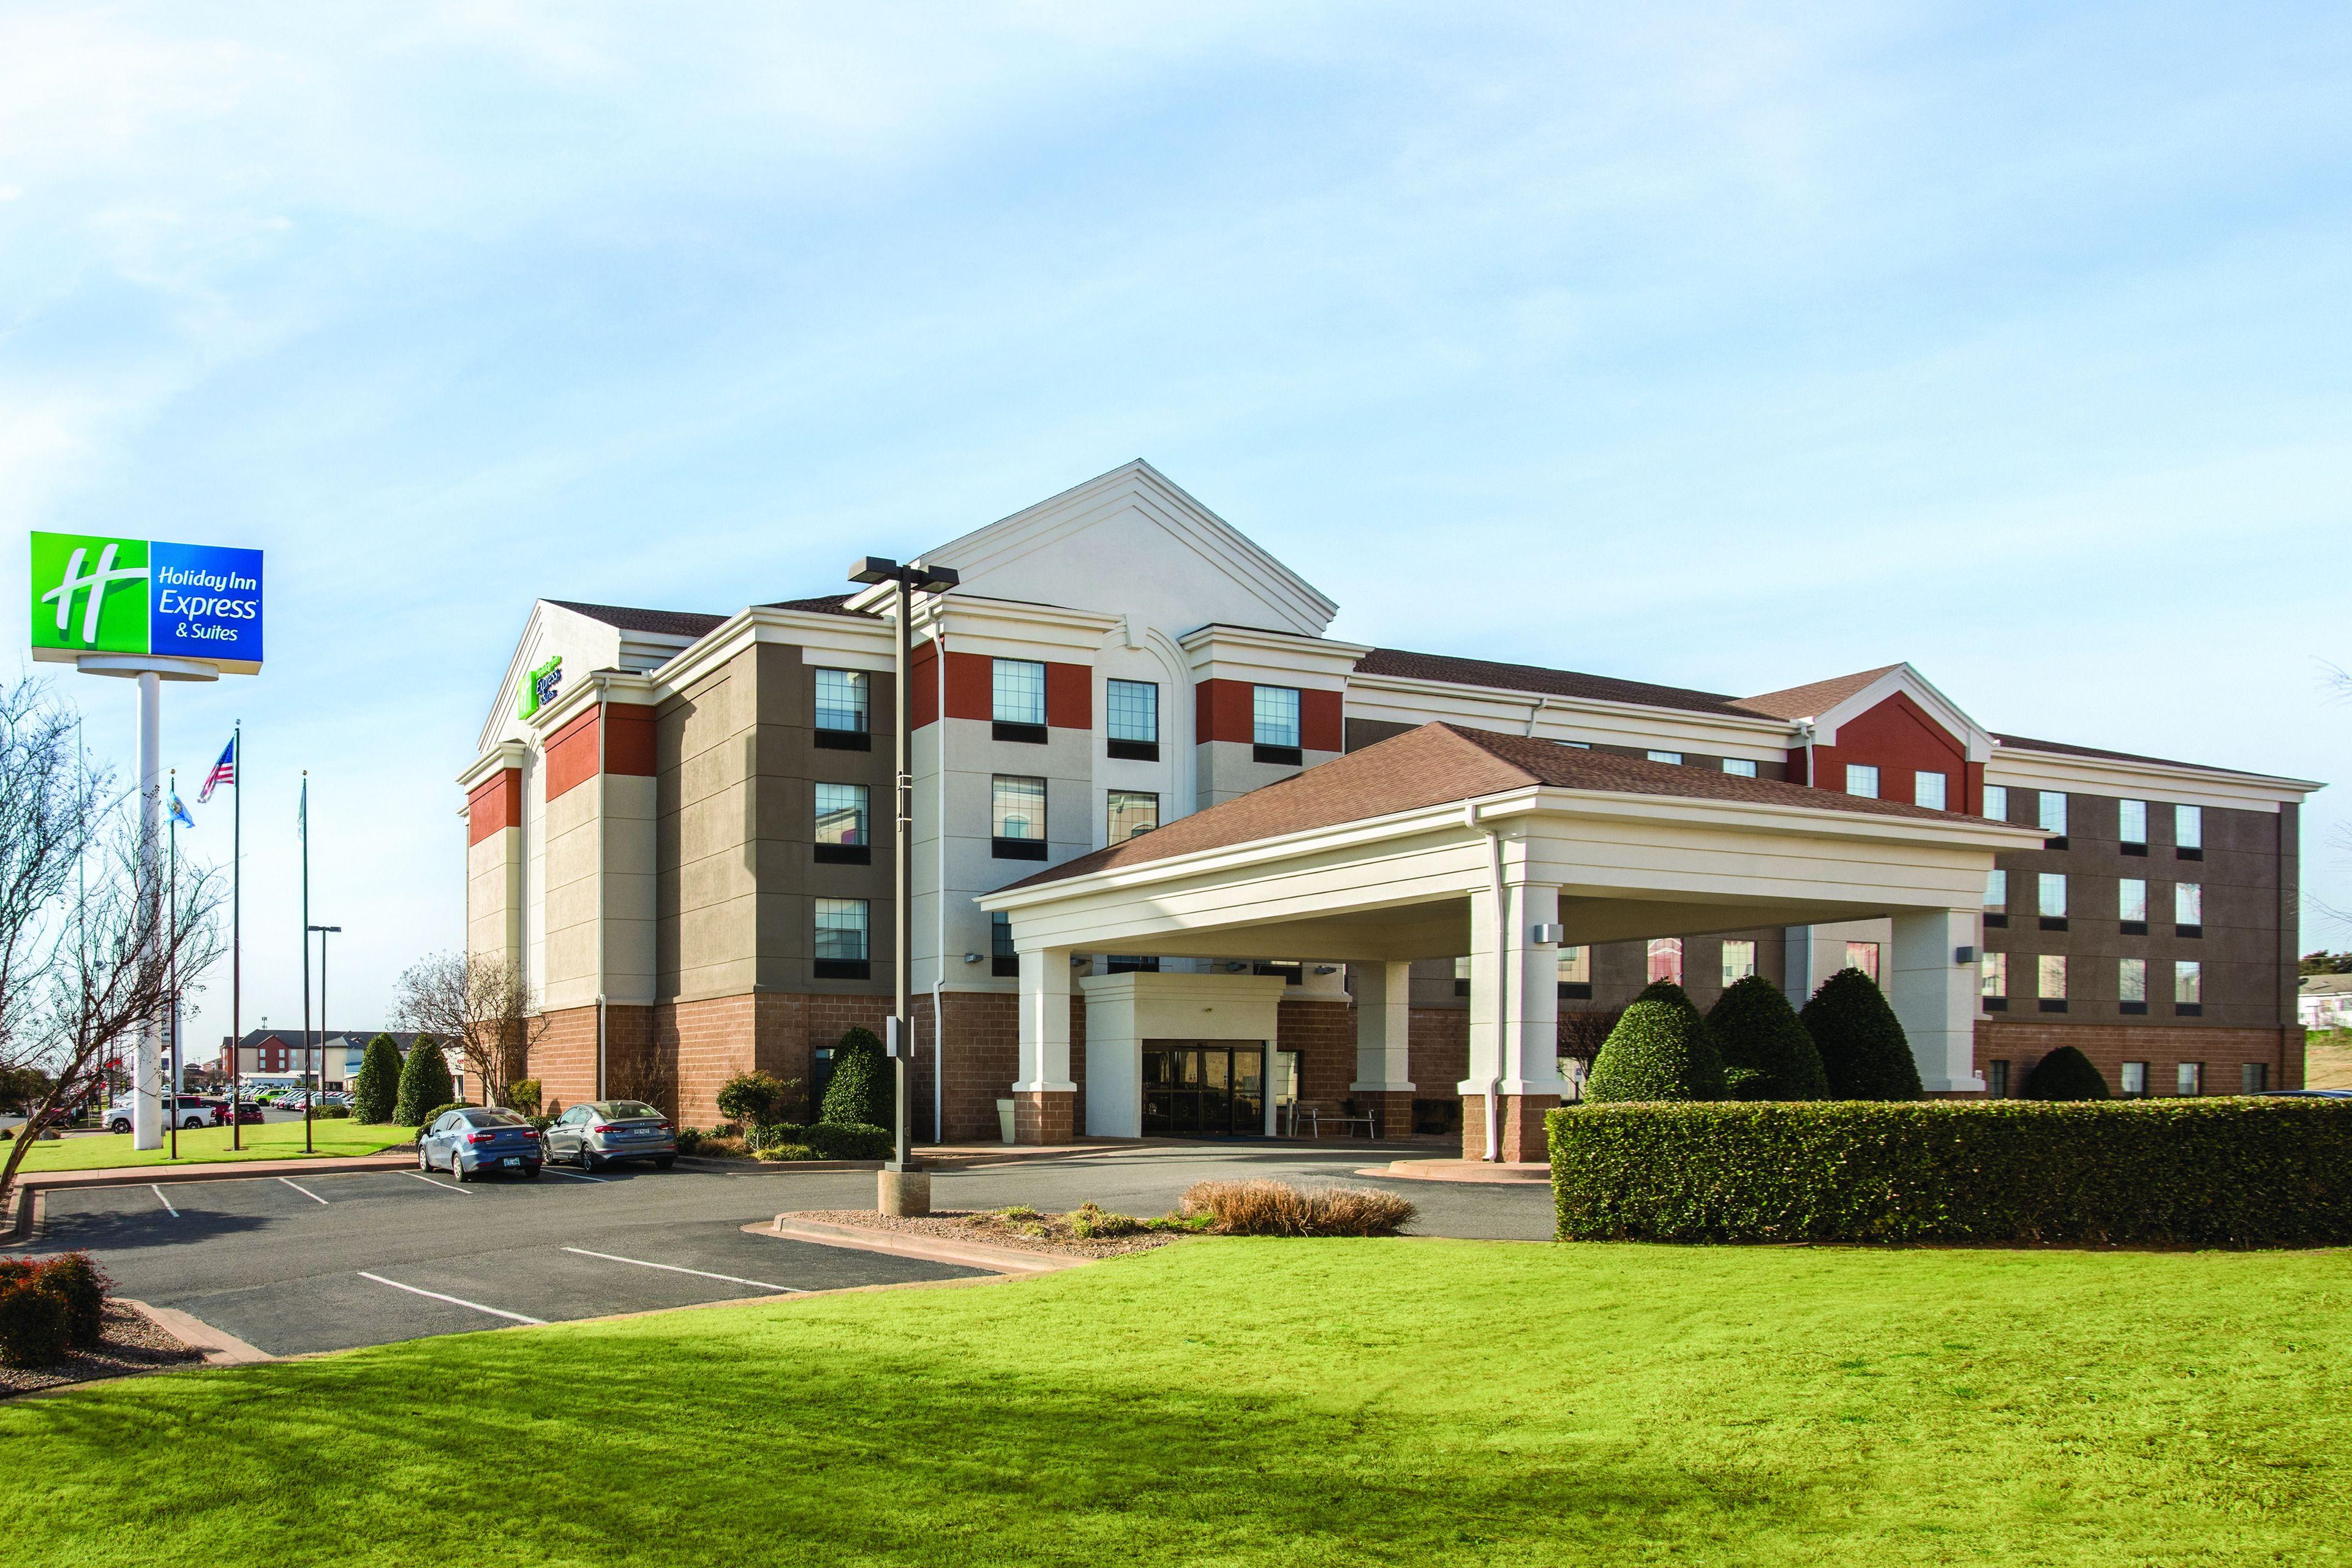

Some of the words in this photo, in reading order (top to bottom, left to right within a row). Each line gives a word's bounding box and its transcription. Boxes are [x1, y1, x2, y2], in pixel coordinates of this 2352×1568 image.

[158, 566, 227, 592] Holiday
[229, 571, 257, 590] Inn
[159, 589, 257, 621] Express
[176, 622, 188, 638] &
[190, 624, 238, 641] Suites
